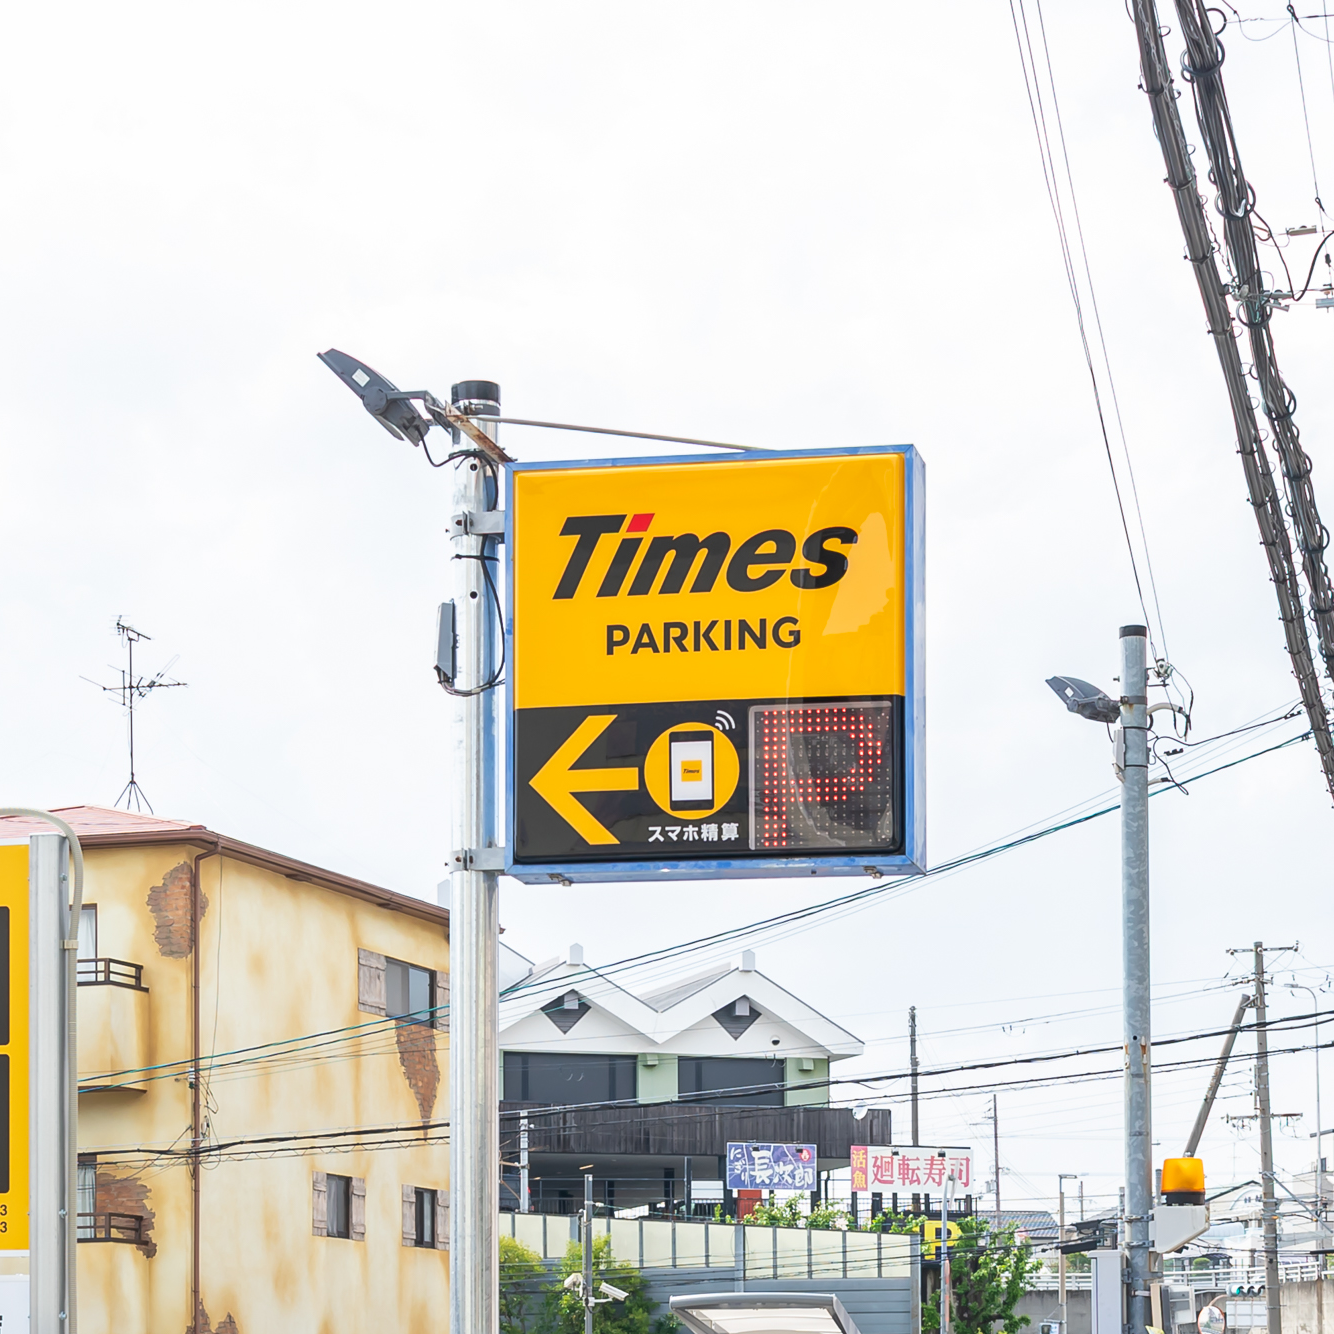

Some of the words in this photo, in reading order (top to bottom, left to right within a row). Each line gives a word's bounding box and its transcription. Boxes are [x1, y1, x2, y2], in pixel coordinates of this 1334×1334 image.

[552, 513, 859, 600] Times
[606, 616, 802, 656] PARKING
[647, 822, 740, 843] スマホ精算
[852, 1150, 867, 1188] 活魚
